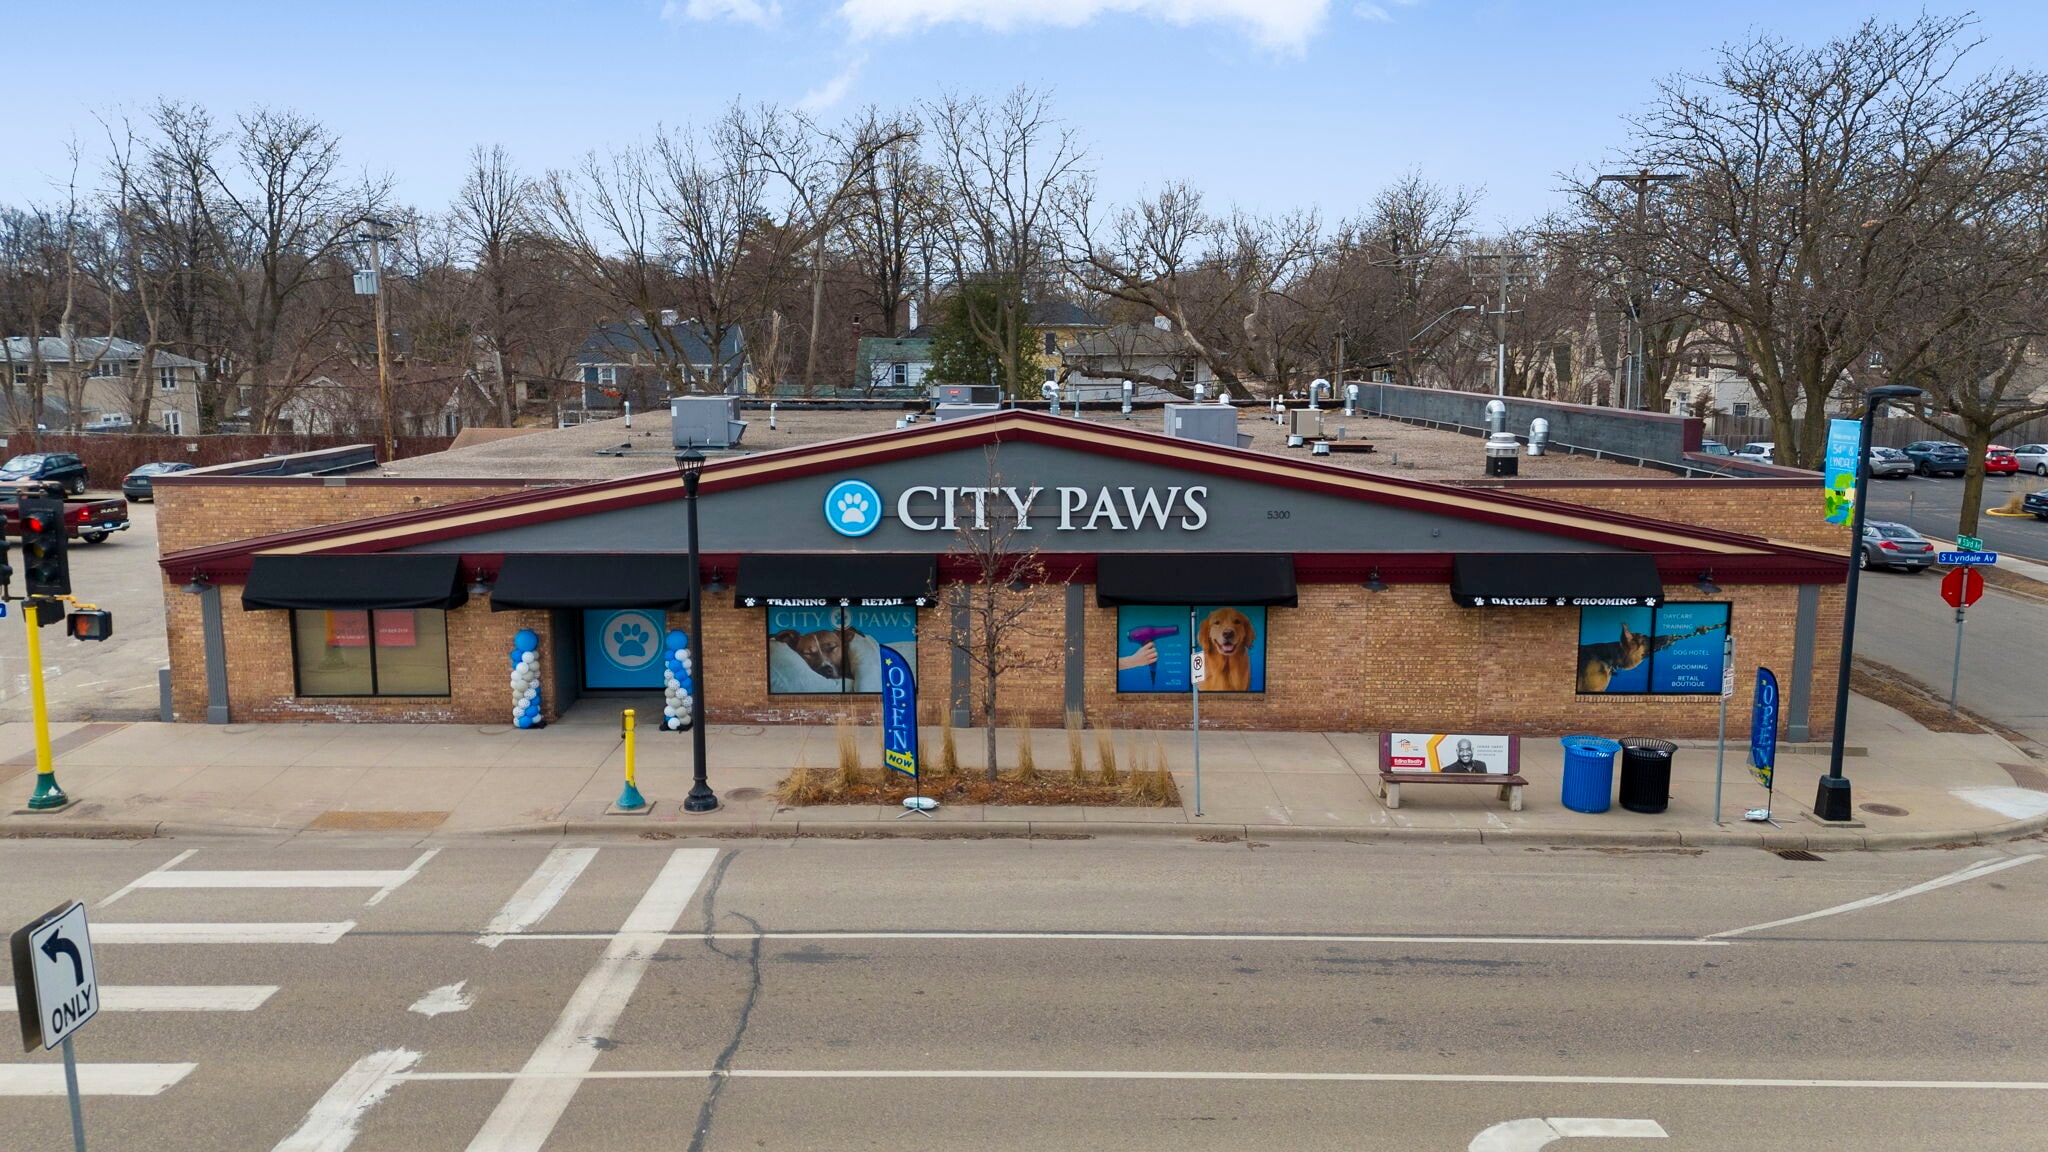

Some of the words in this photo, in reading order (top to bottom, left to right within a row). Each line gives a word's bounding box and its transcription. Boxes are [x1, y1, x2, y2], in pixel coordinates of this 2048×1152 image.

[898, 486, 1044, 531] CITY
[1056, 486, 1208, 531] PAWS
[1267, 510, 1290, 519] 5300
[1962, 538, 1974, 548] 53rd
[1949, 554, 1981, 564] Lyndale
[767, 598, 827, 606] TRAINING
[861, 598, 903, 606] RETAIL
[1491, 597, 1548, 606] DAYCARE
[1572, 597, 1637, 606] GROOMING
[775, 611, 824, 628] CITY
[858, 612, 912, 628] PAWS
[888, 666, 907, 750] OPEN
[888, 754, 912, 769] NOW
[52, 984, 91, 1034] ONLY
